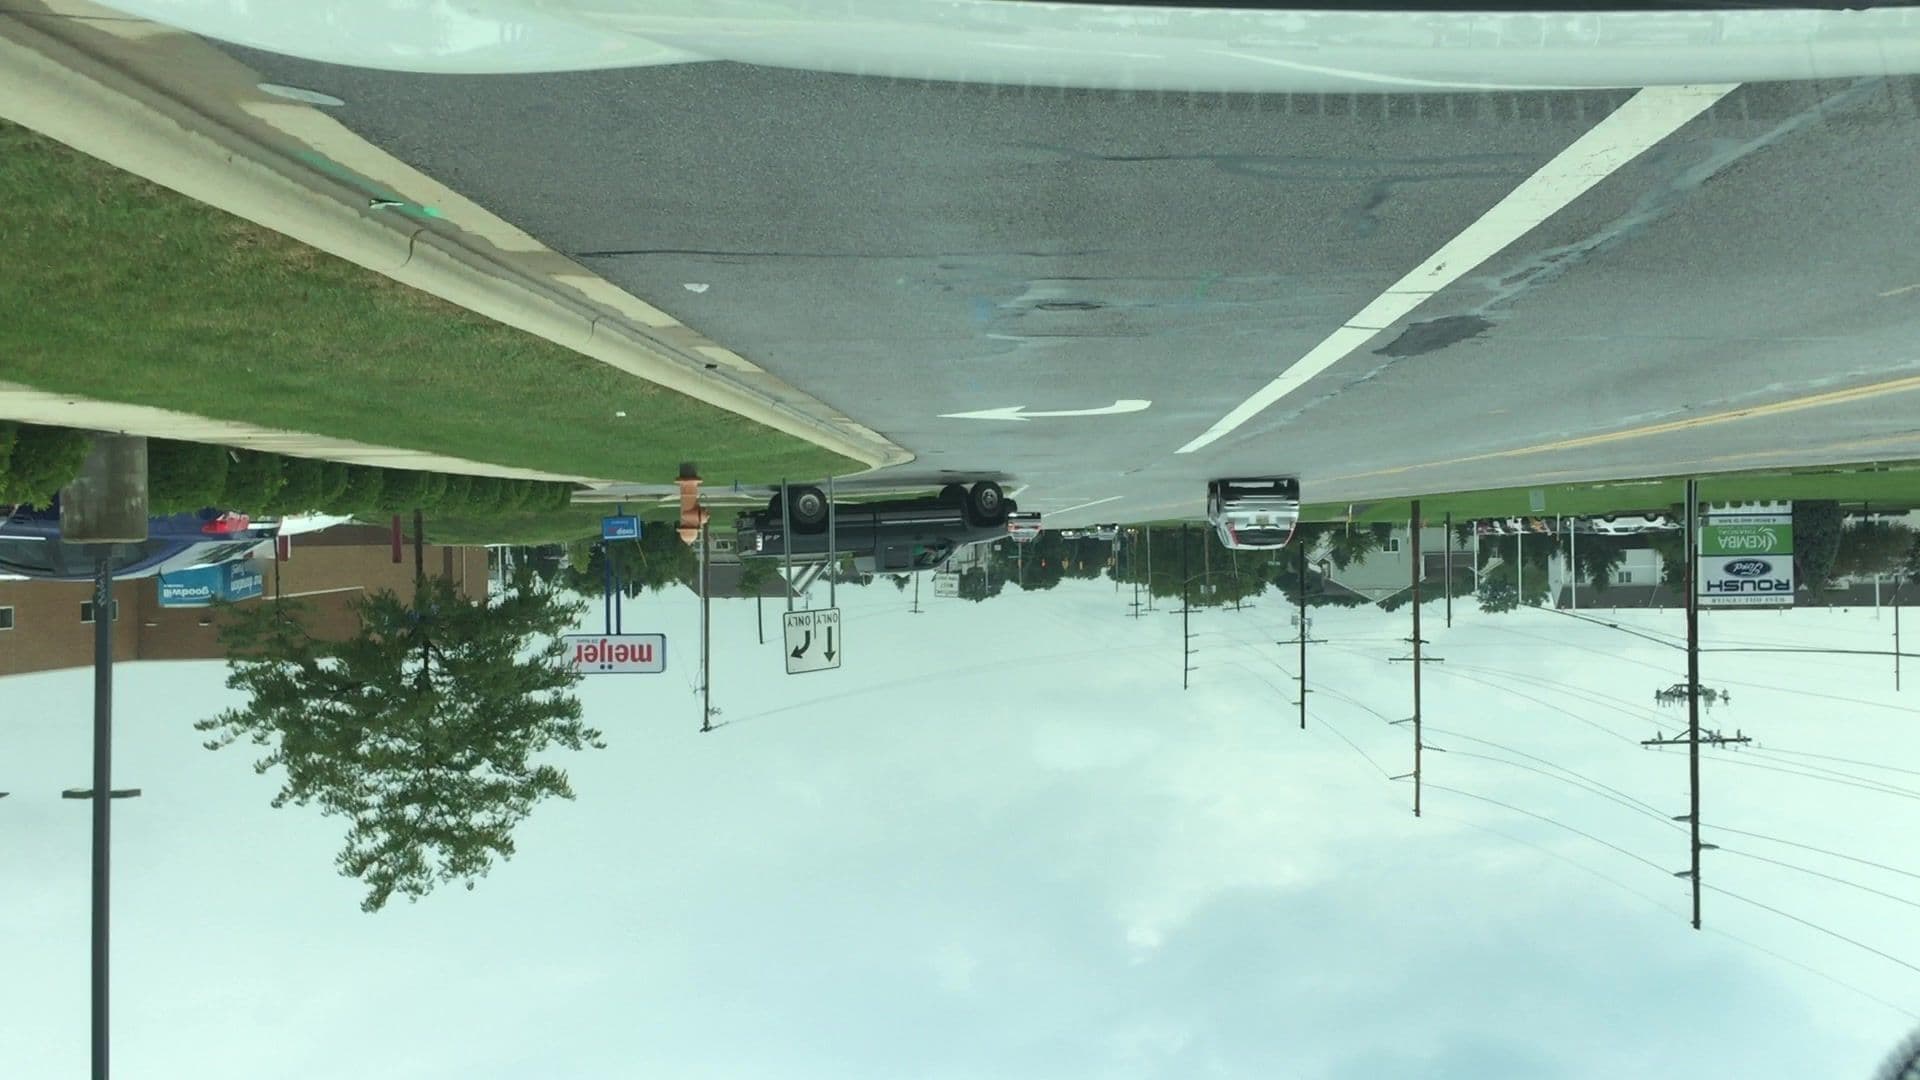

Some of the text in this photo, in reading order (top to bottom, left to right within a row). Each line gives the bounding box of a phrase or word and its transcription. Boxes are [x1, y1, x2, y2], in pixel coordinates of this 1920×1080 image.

[1718, 535, 1766, 549] KEMBA
[1734, 562, 1764, 576] Ford
[163, 586, 209, 598] goodwill
[1707, 579, 1790, 592] ROUSH
[787, 615, 811, 627] ONLY
[816, 613, 838, 625] ONLY
[573, 639, 653, 670] meijer
